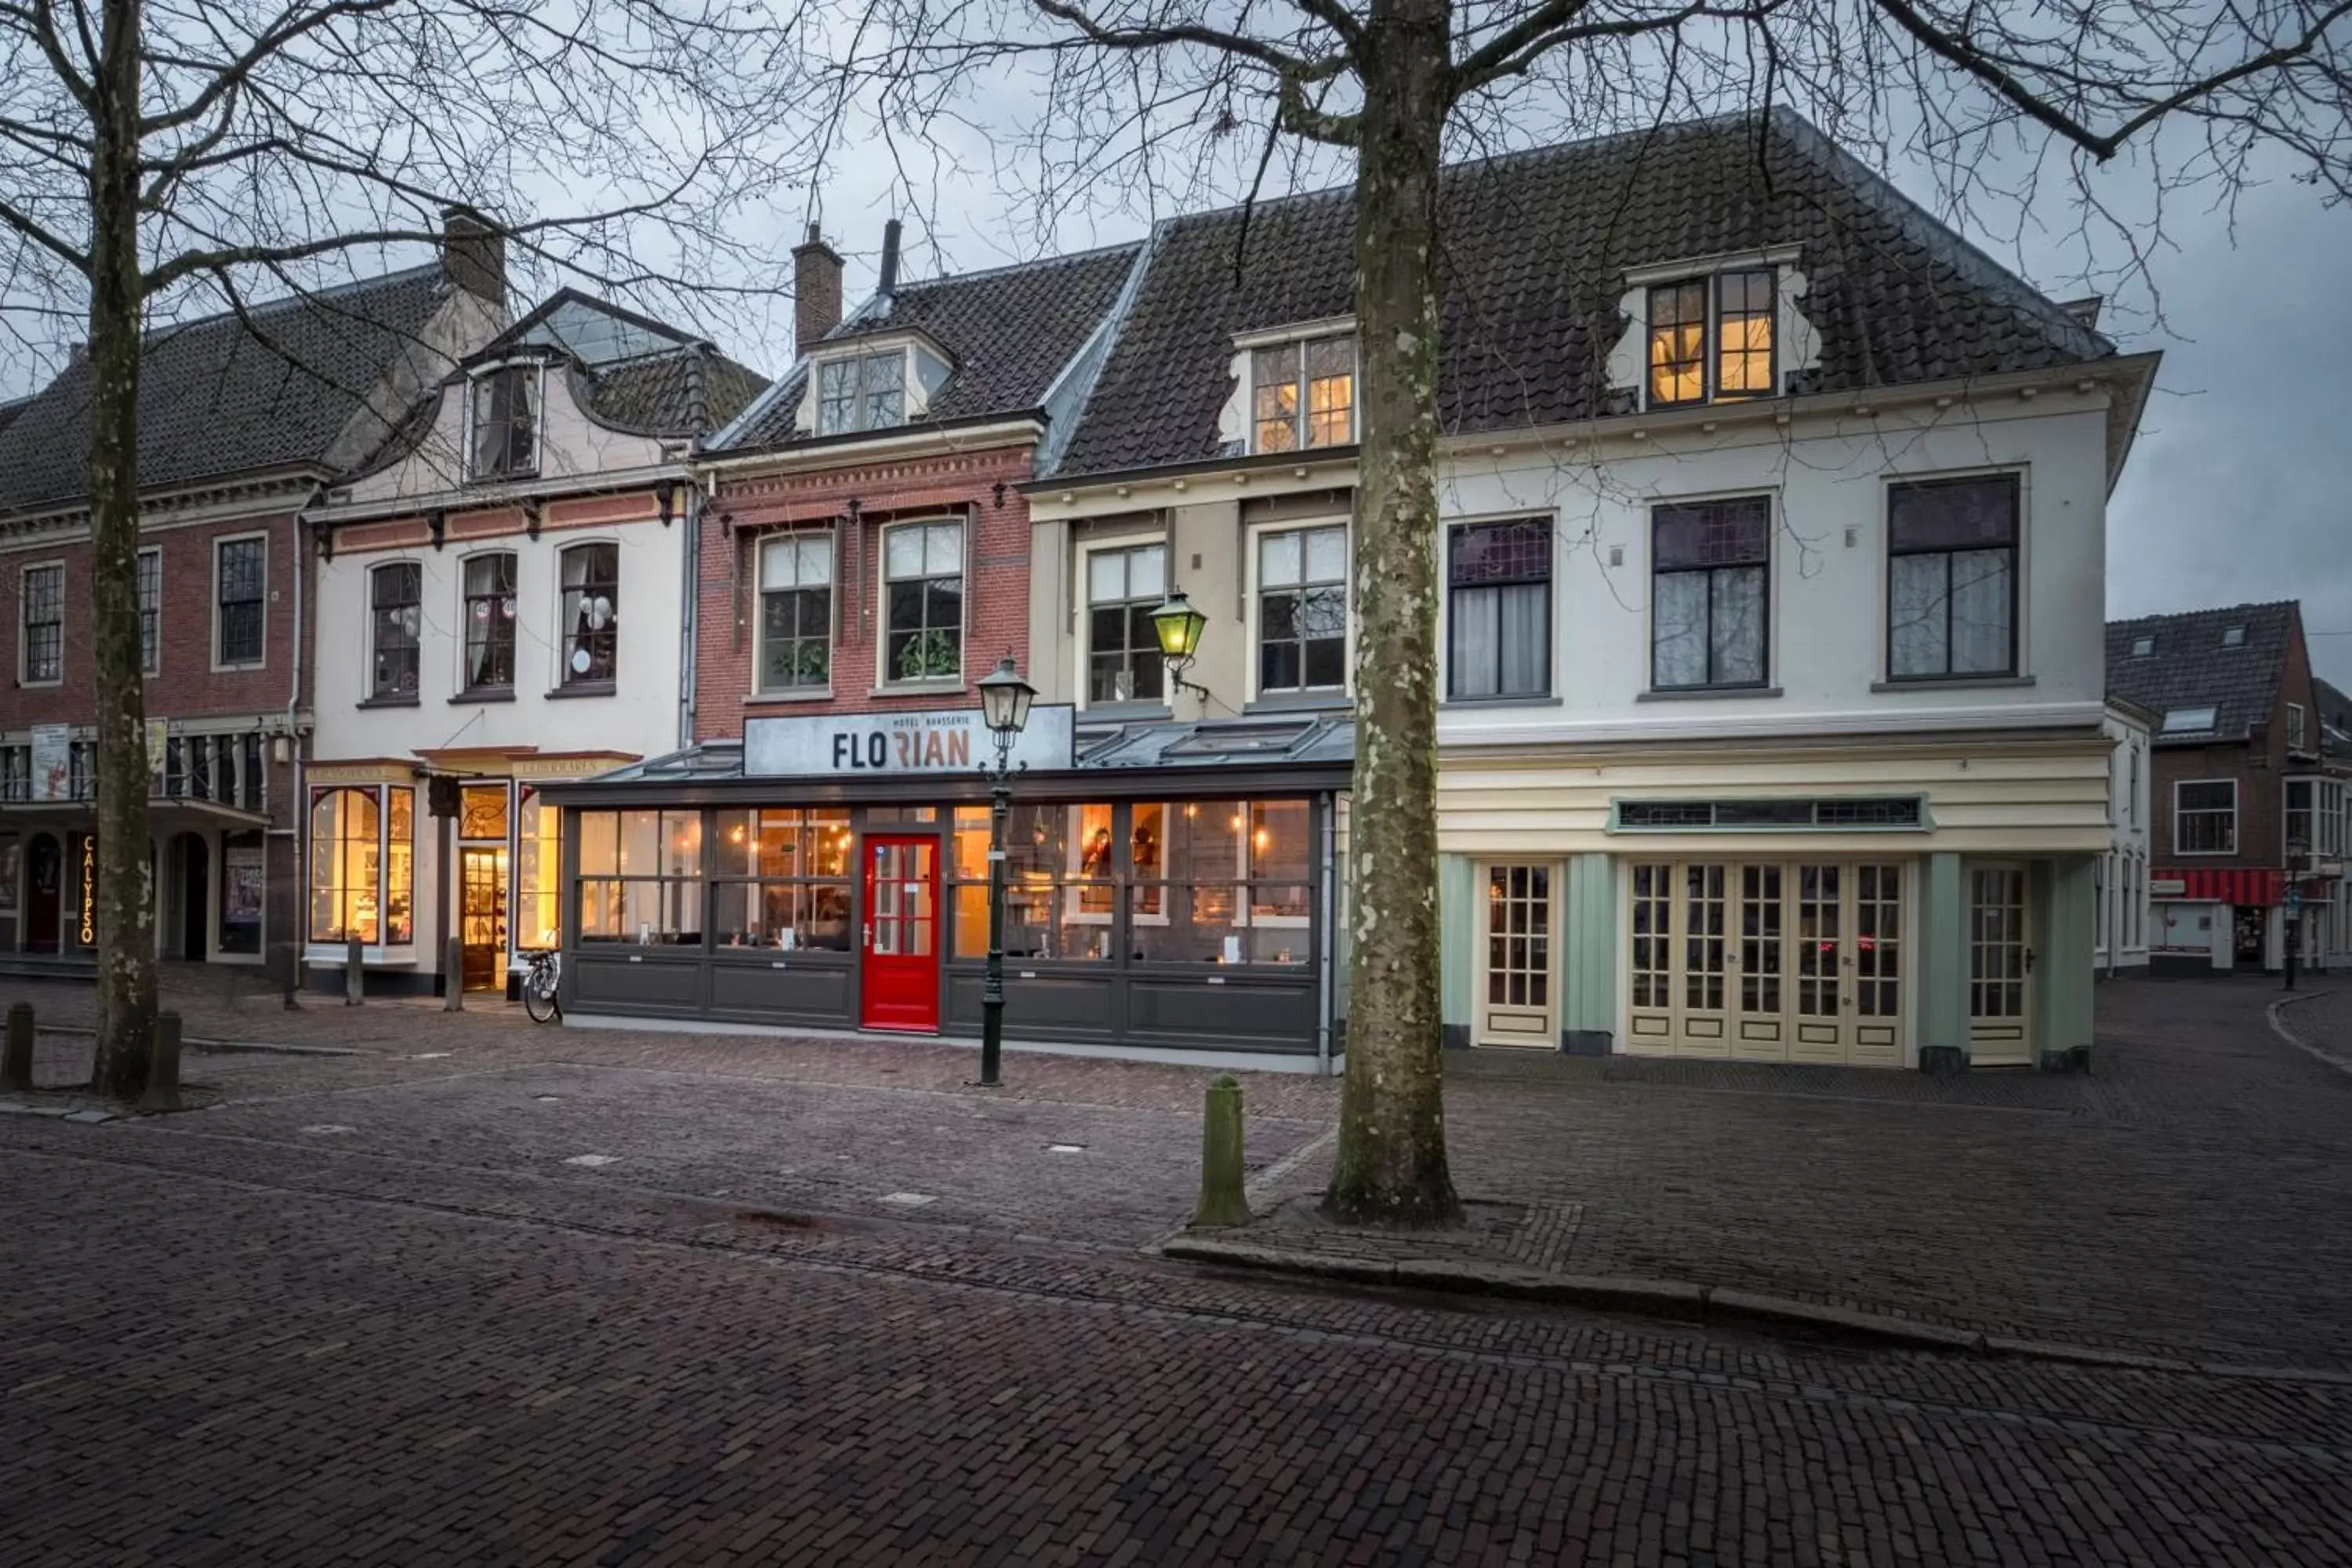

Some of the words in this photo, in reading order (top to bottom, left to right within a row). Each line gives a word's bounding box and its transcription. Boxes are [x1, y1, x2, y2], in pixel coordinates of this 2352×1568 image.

[893, 717, 919, 728] HOTEL
[926, 715, 970, 727] BRASSERIE
[833, 729, 969, 768] FLORIAN
[81, 835, 94, 943] CALYPSO
